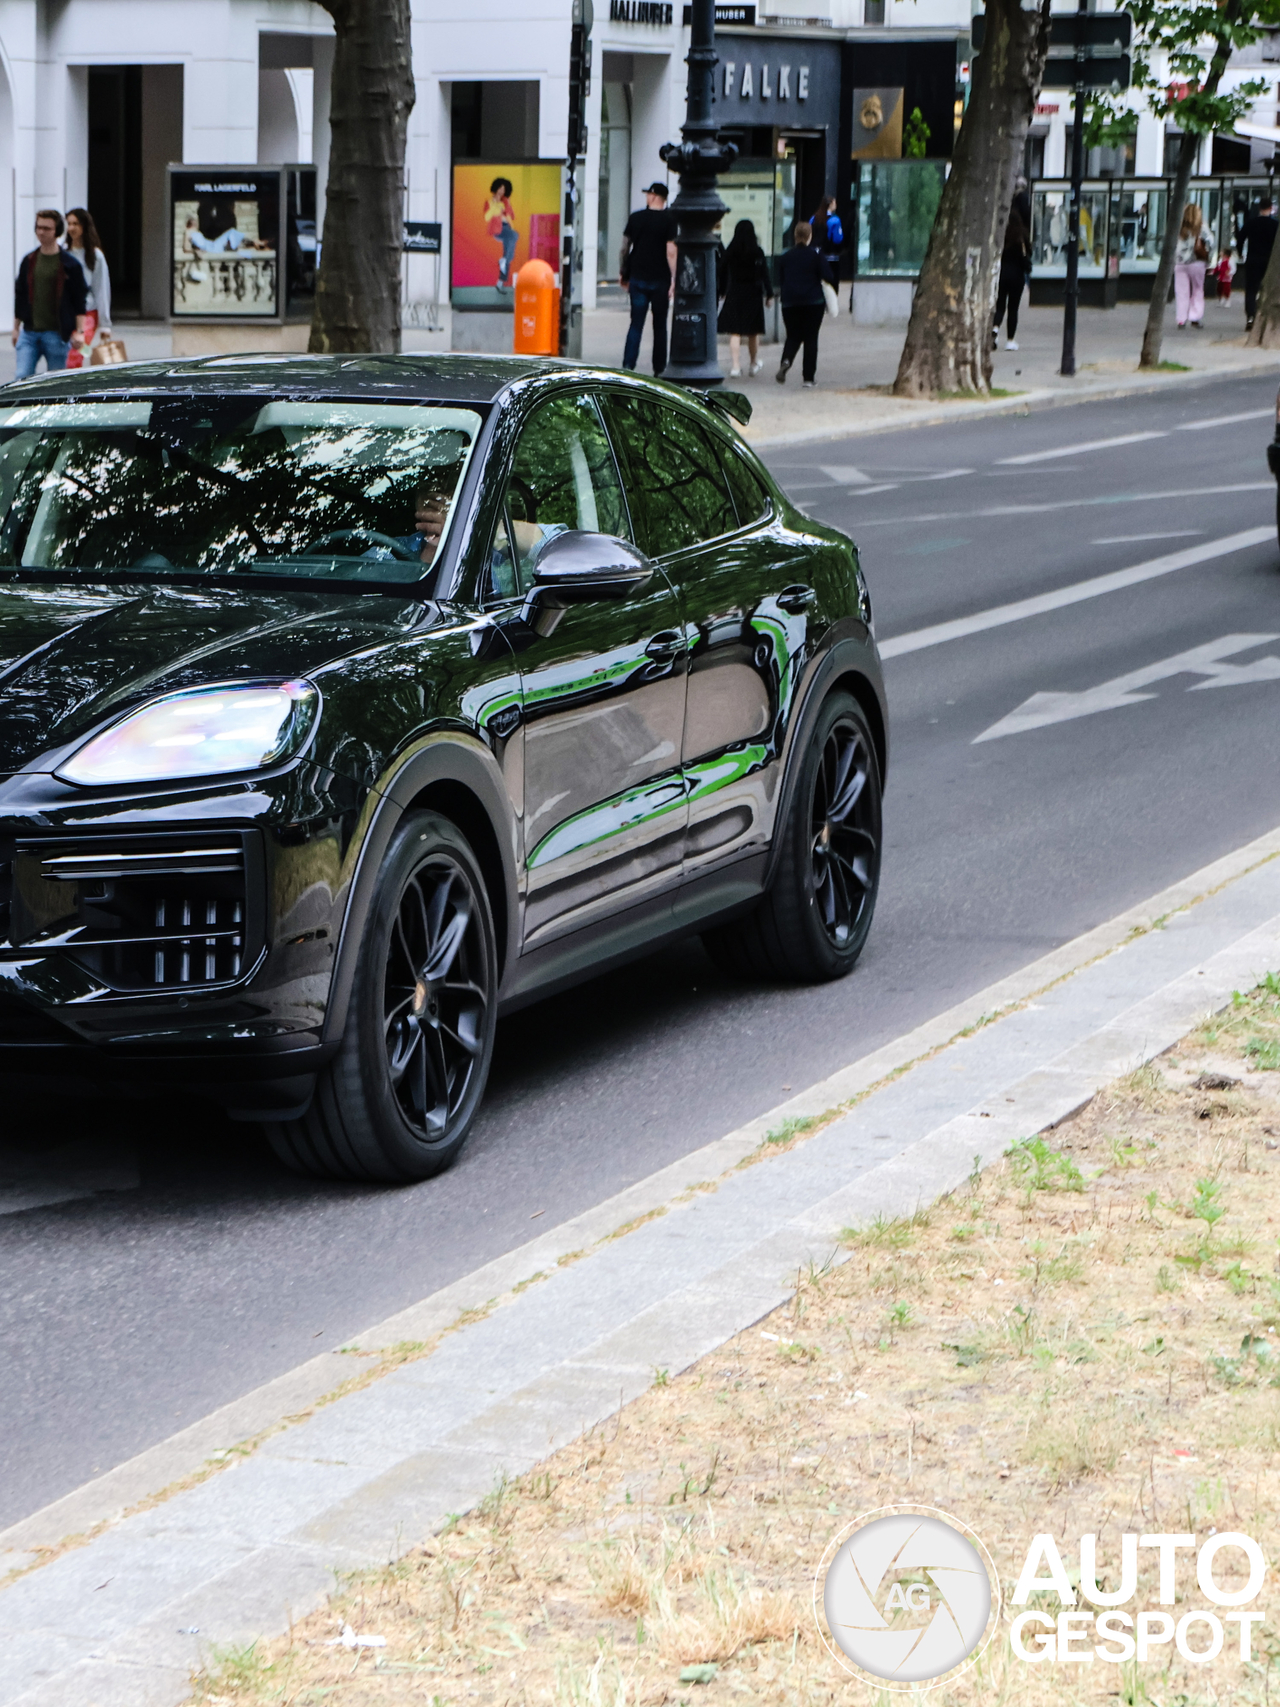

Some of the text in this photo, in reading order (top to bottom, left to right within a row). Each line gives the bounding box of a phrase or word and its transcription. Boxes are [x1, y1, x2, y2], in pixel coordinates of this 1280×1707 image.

[609, 0, 673, 24] HALLHUBER
[715, 9, 746, 20] HUBER
[724, 62, 810, 99] FALKE
